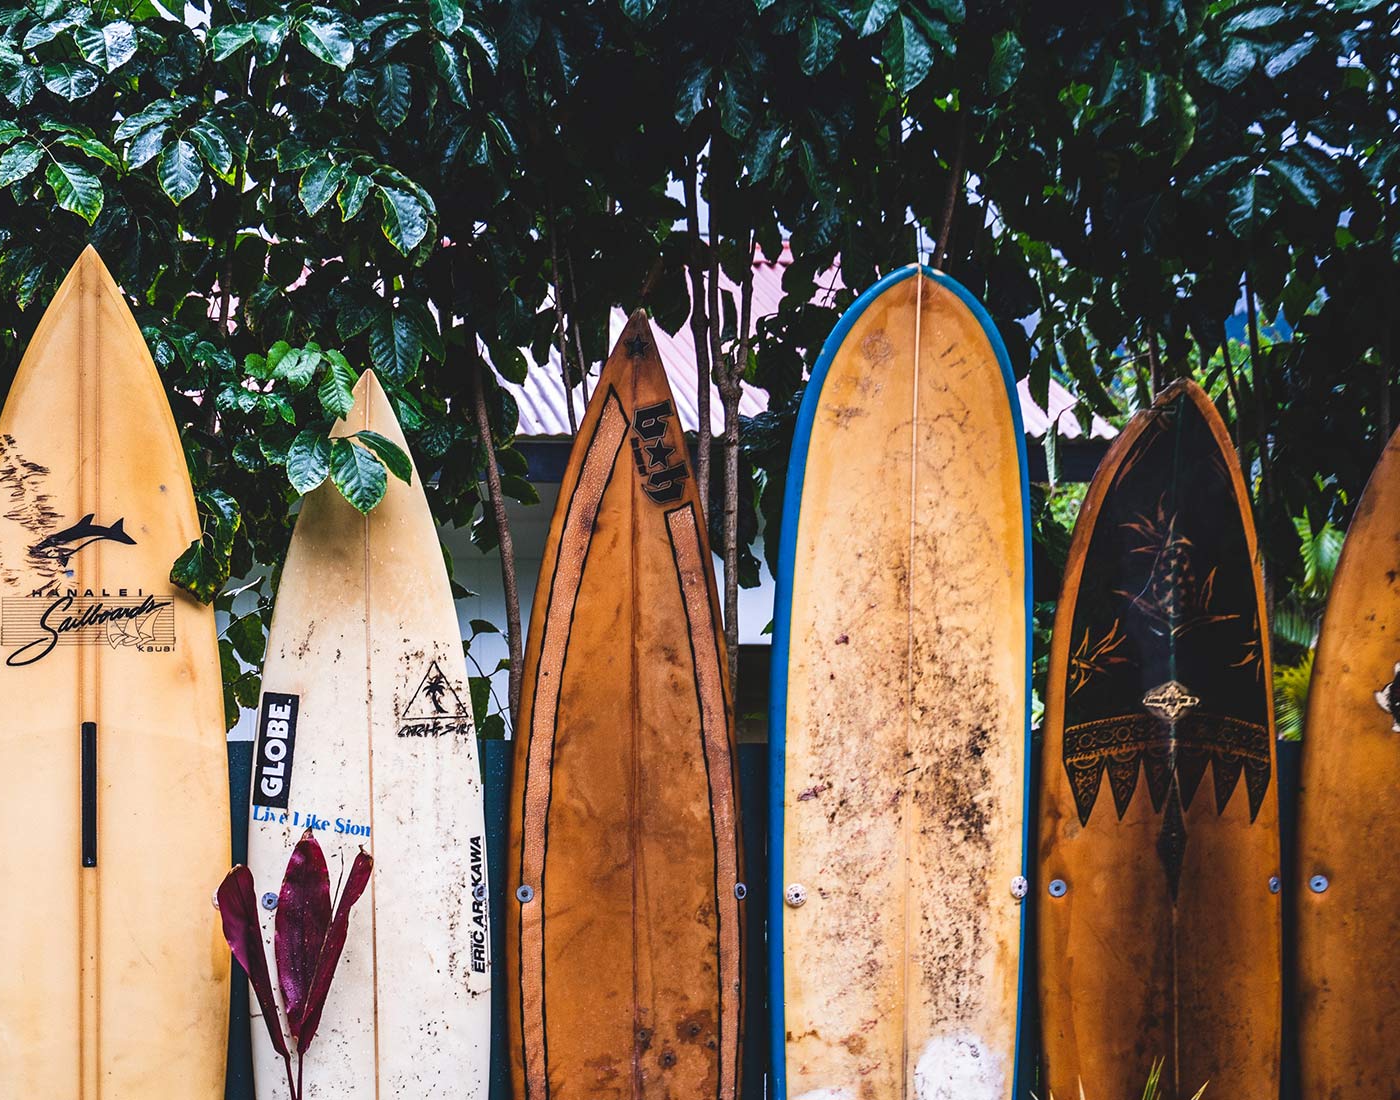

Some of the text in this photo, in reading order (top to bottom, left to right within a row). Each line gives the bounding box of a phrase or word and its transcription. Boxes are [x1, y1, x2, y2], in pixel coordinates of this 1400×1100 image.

[32, 588, 143, 598] HANALEI
[6, 595, 172, 666] Sailboards
[261, 702, 291, 798] GLOBE
[293, 811, 330, 832] Like
[334, 817, 371, 837] Sion
[473, 930, 486, 973] ERIC
